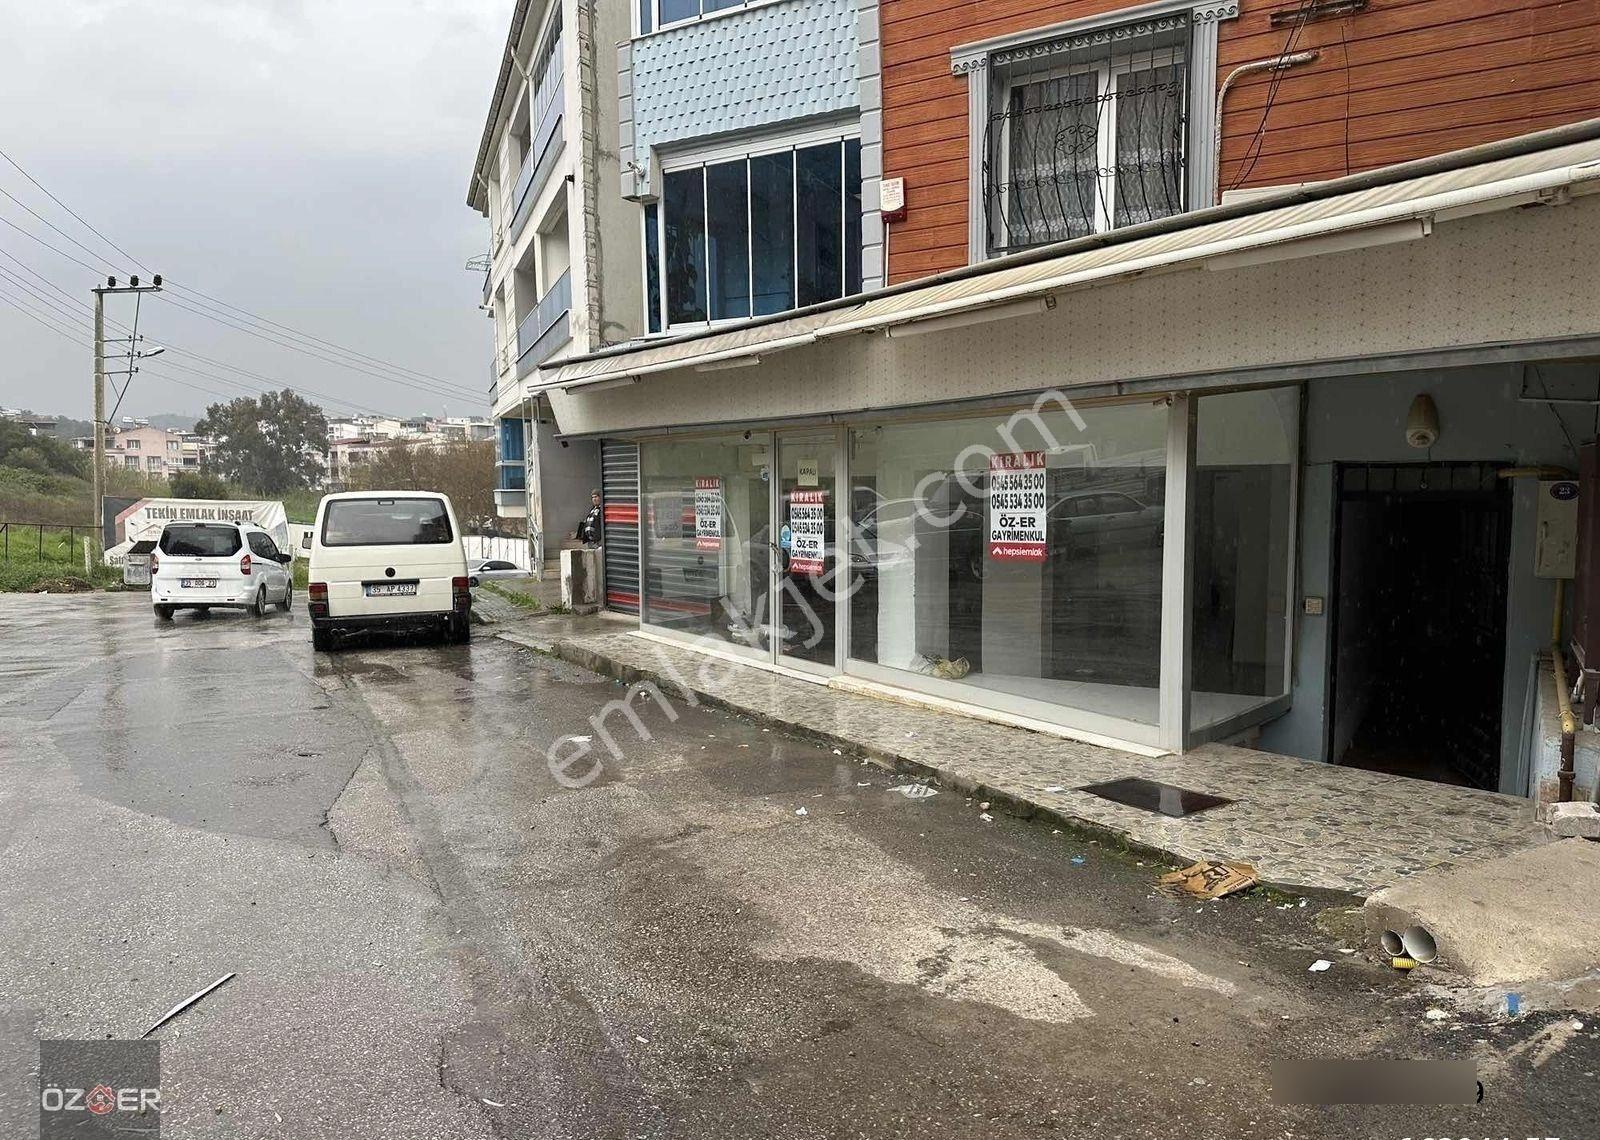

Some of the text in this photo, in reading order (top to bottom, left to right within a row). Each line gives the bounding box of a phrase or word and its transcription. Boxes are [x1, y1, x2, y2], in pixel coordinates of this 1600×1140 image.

[1033, 472, 1045, 490] 00
[991, 492, 1045, 509] 0545 534 35 00
[144, 506, 177, 520] TEKİN
[180, 508, 215, 520] EMLAK
[999, 513, 1036, 528] ÖZ-ER
[991, 528, 1045, 541] GAYRİMENKUL
[796, 538, 818, 549] ÖZ-ER
[1003, 546, 1043, 557] hepsiemlak
